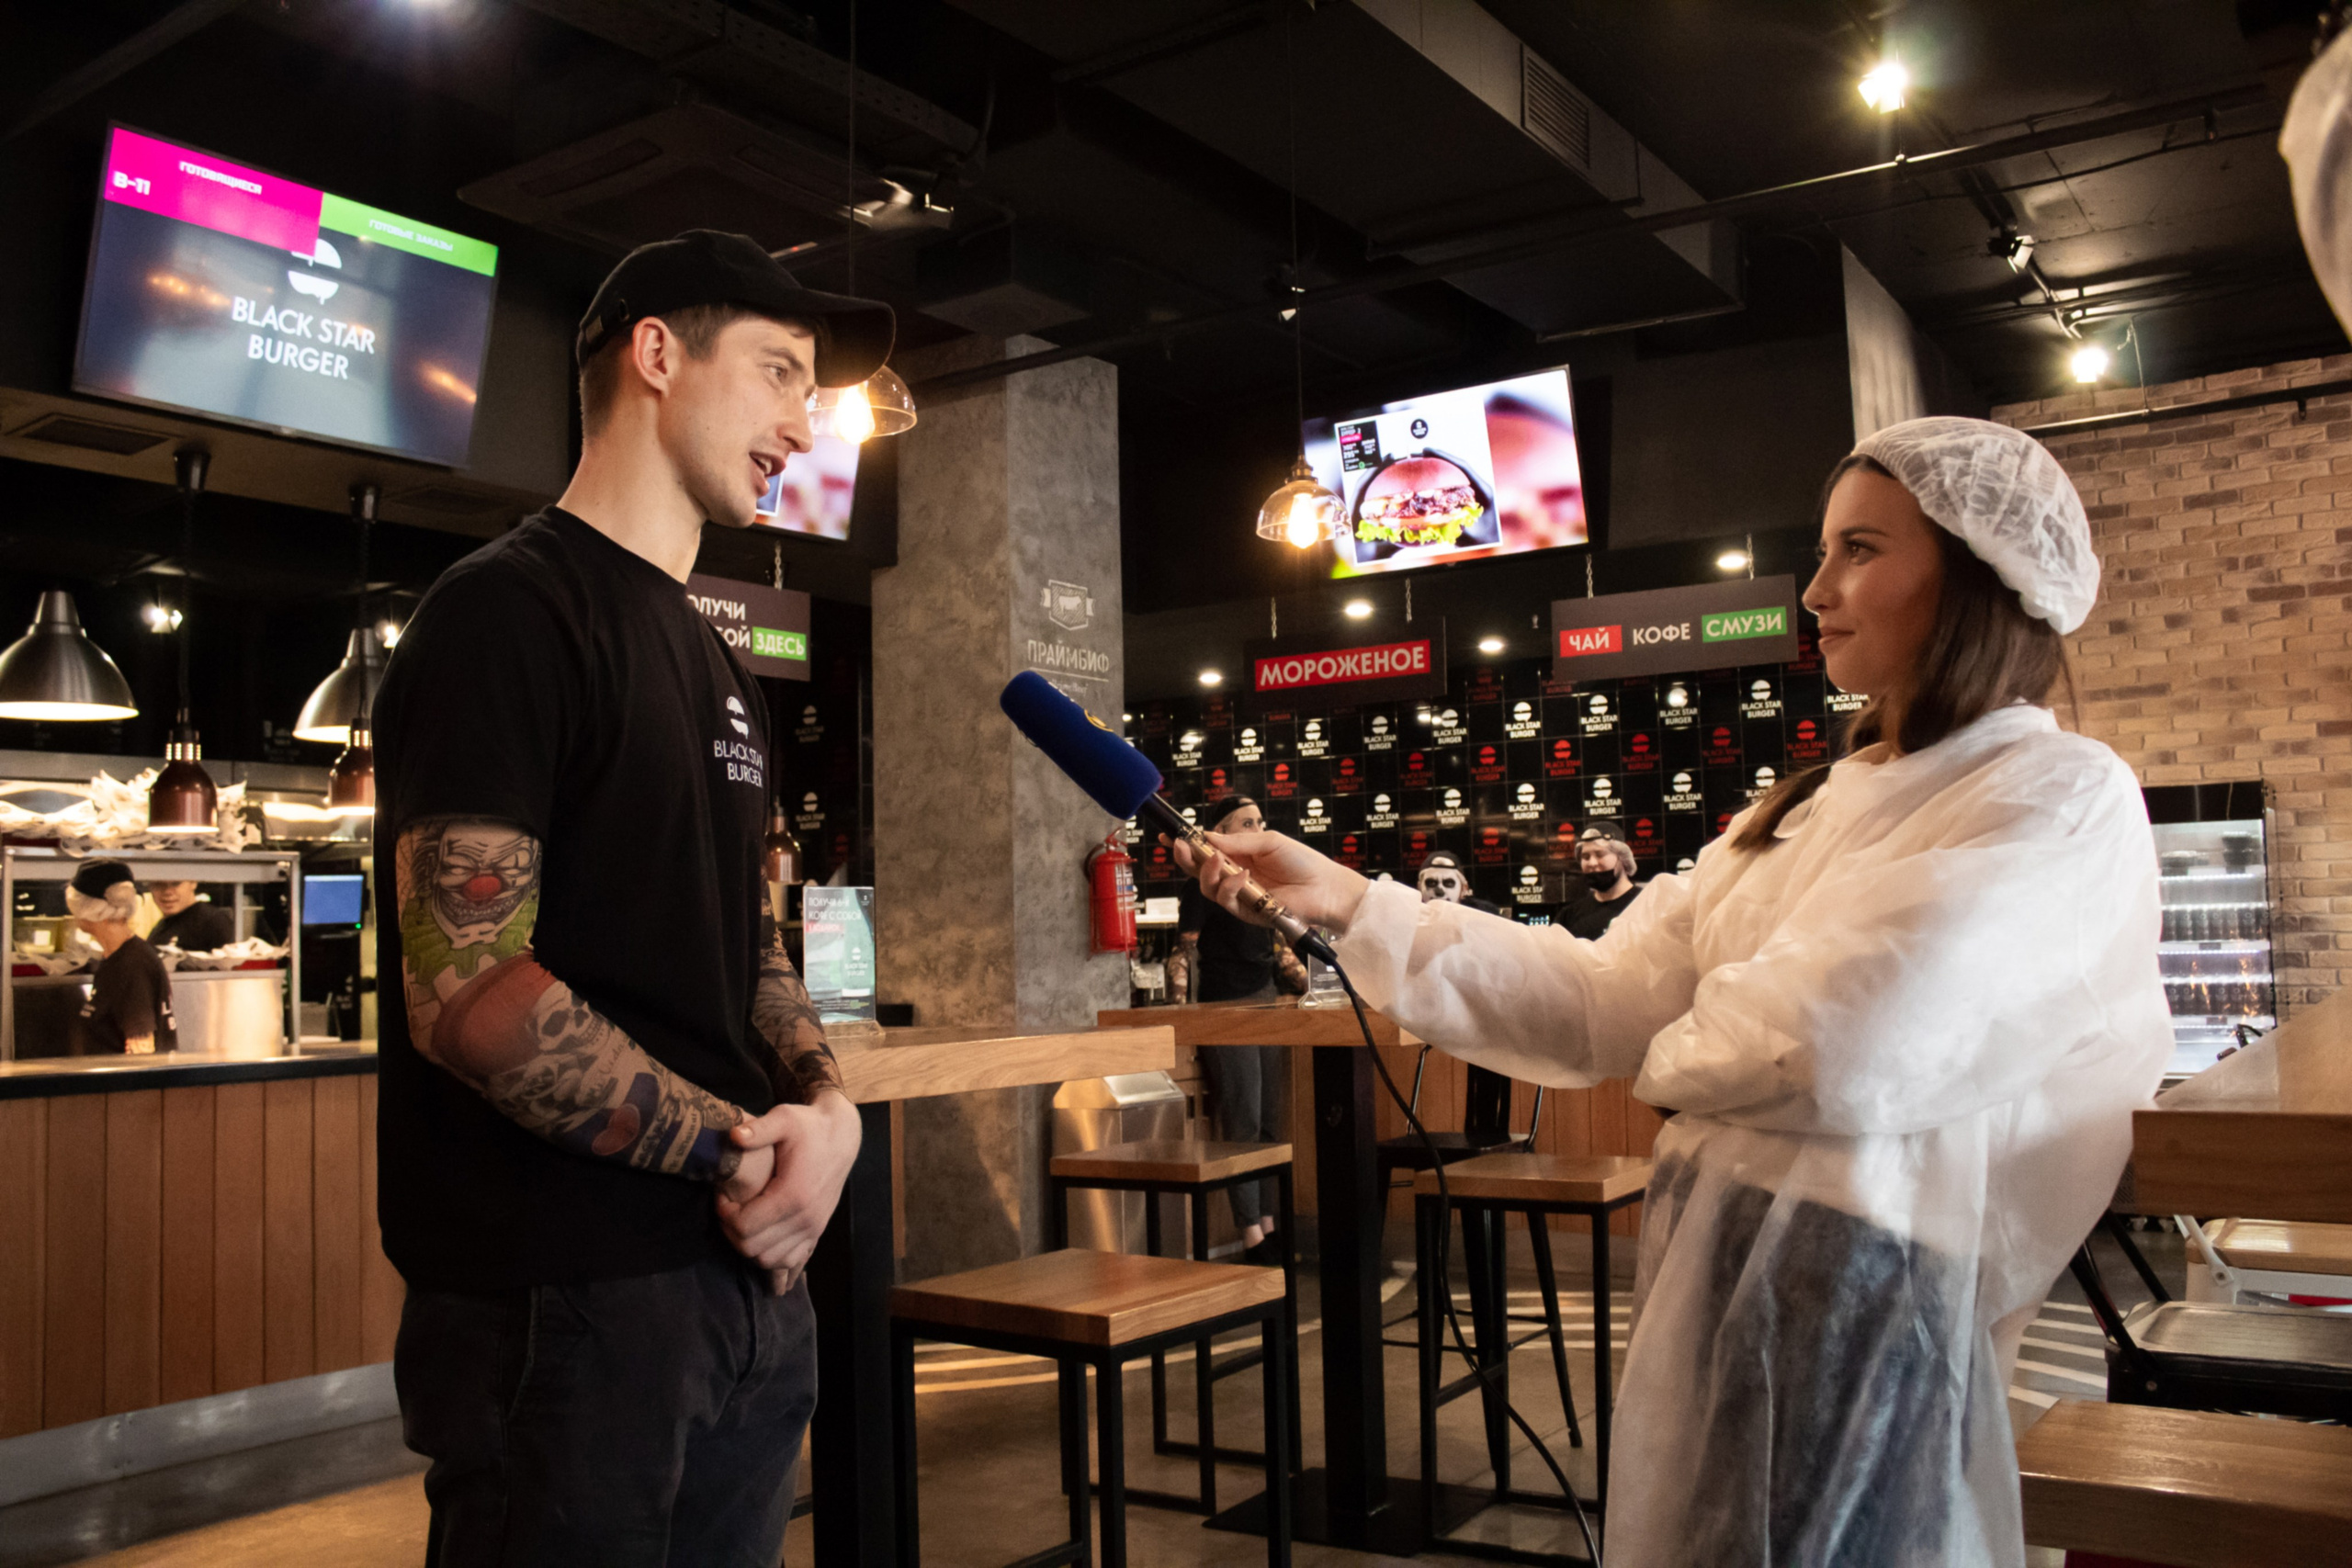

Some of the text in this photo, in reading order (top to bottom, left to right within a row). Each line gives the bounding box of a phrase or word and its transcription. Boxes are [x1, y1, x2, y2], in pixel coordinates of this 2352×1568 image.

[369, 219, 453, 252] ГОТОВЫЕ ЗАКАЗЫ
[232, 296, 376, 355] BLACK STAR
[247, 333, 349, 380] BURGER
[1568, 612, 1782, 652] ЧАЙ КОФЕ СМУЗИ
[756, 633, 805, 656] ЗДЕСЬ
[1028, 639, 1109, 673] ПРАЙМБИФ
[1260, 646, 1425, 685] МОРОЖЕНОЕ
[1827, 694, 1849, 705] BLACK
[1742, 700, 1782, 711] BLACK STAR
[1832, 702, 1863, 713] BURGER
[1659, 707, 1698, 718] BLACK STAR
[1747, 709, 1776, 719] BURGER
[1580, 715, 1618, 725] BLACK STAR
[1665, 716, 1692, 726] BURGER
[1505, 721, 1542, 731] BLACK STAR
[1586, 723, 1613, 732] BURGER
[1433, 728, 1467, 738] BLACK STAR
[1510, 729, 1536, 739] BURGER
[1363, 734, 1396, 744] BLACK STAR
[1437, 736, 1463, 746] BURGER
[1297, 739, 1330, 750] BLACK STAR
[1368, 742, 1393, 751] BURGER
[714, 739, 750, 761] BLACK
[1233, 746, 1264, 756] BLACK STAR
[1301, 748, 1325, 757] BURGER
[1237, 754, 1261, 762] BURGER
[1584, 797, 1623, 808] BLACK STAR
[1663, 792, 1702, 803] BLACK STAR
[1509, 803, 1545, 813] BLACK STAR
[1668, 801, 1697, 810] BURGER
[1589, 807, 1617, 816] BURGER
[1299, 817, 1332, 827] BLACK STAR
[1366, 812, 1400, 822] BLACK STAR
[1441, 816, 1466, 825] BURGER
[1304, 825, 1327, 833] BURGER
[1371, 821, 1395, 829] BURGER
[1511, 886, 1532, 895] BLACK
